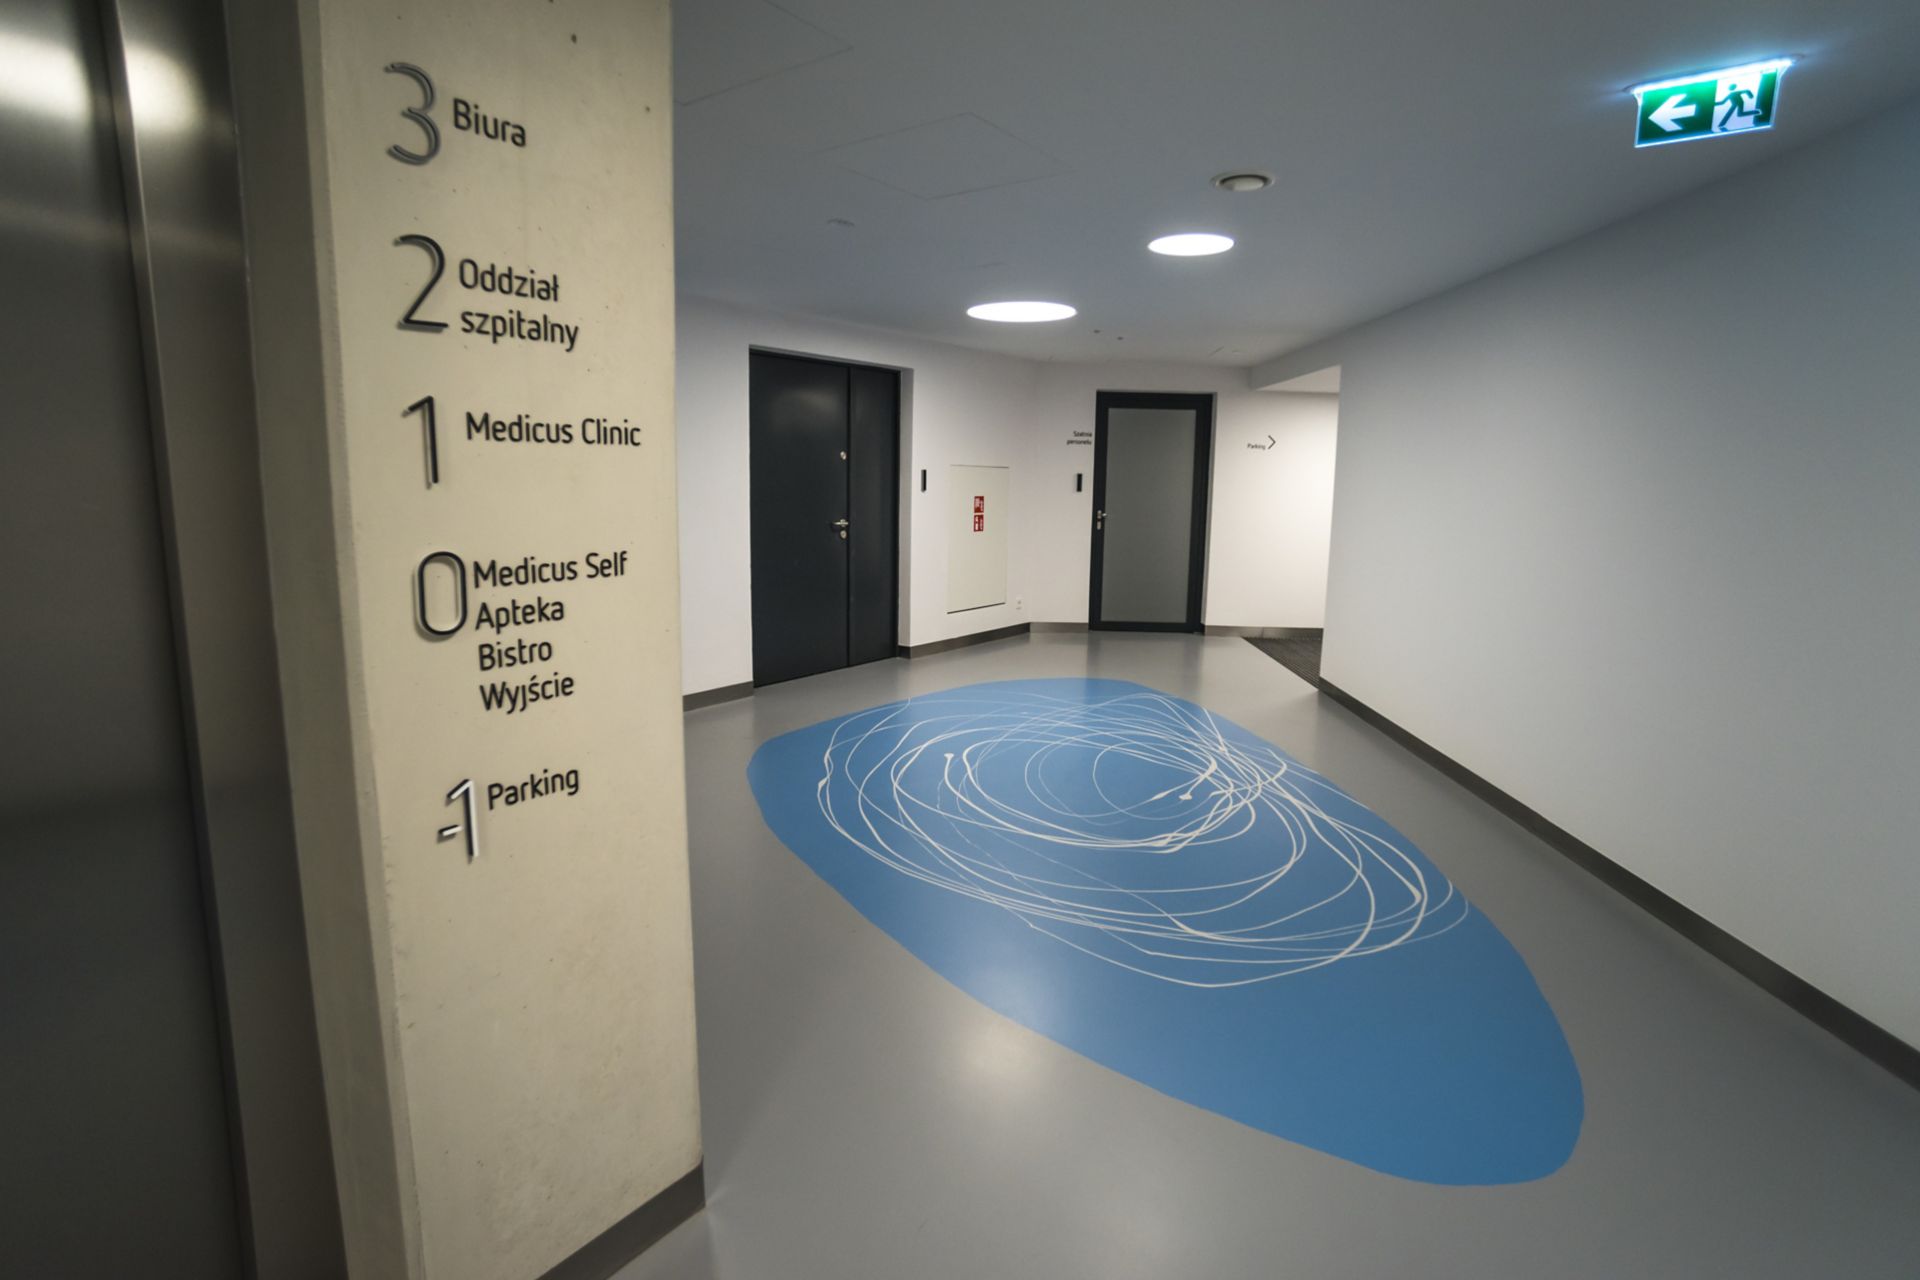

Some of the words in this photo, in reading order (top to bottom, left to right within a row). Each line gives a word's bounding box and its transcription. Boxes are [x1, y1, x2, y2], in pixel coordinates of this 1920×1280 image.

[386, 62, 440, 165] 3
[453, 98, 526, 148] Biura
[395, 234, 448, 332] 2
[459, 258, 560, 301] Oddział
[461, 309, 578, 352] szpitalny
[404, 395, 439, 487] 1
[465, 411, 573, 443] Medicus
[581, 418, 641, 446] Clinic
[473, 556, 578, 589] Medicus
[585, 551, 628, 578] Self
[416, 551, 467, 637] 0
[475, 597, 565, 634] Apteka
[478, 638, 553, 671] Bistro
[479, 672, 574, 714] Wyjście
[487, 769, 580, 810] Parking
[438, 779, 479, 858] -1
